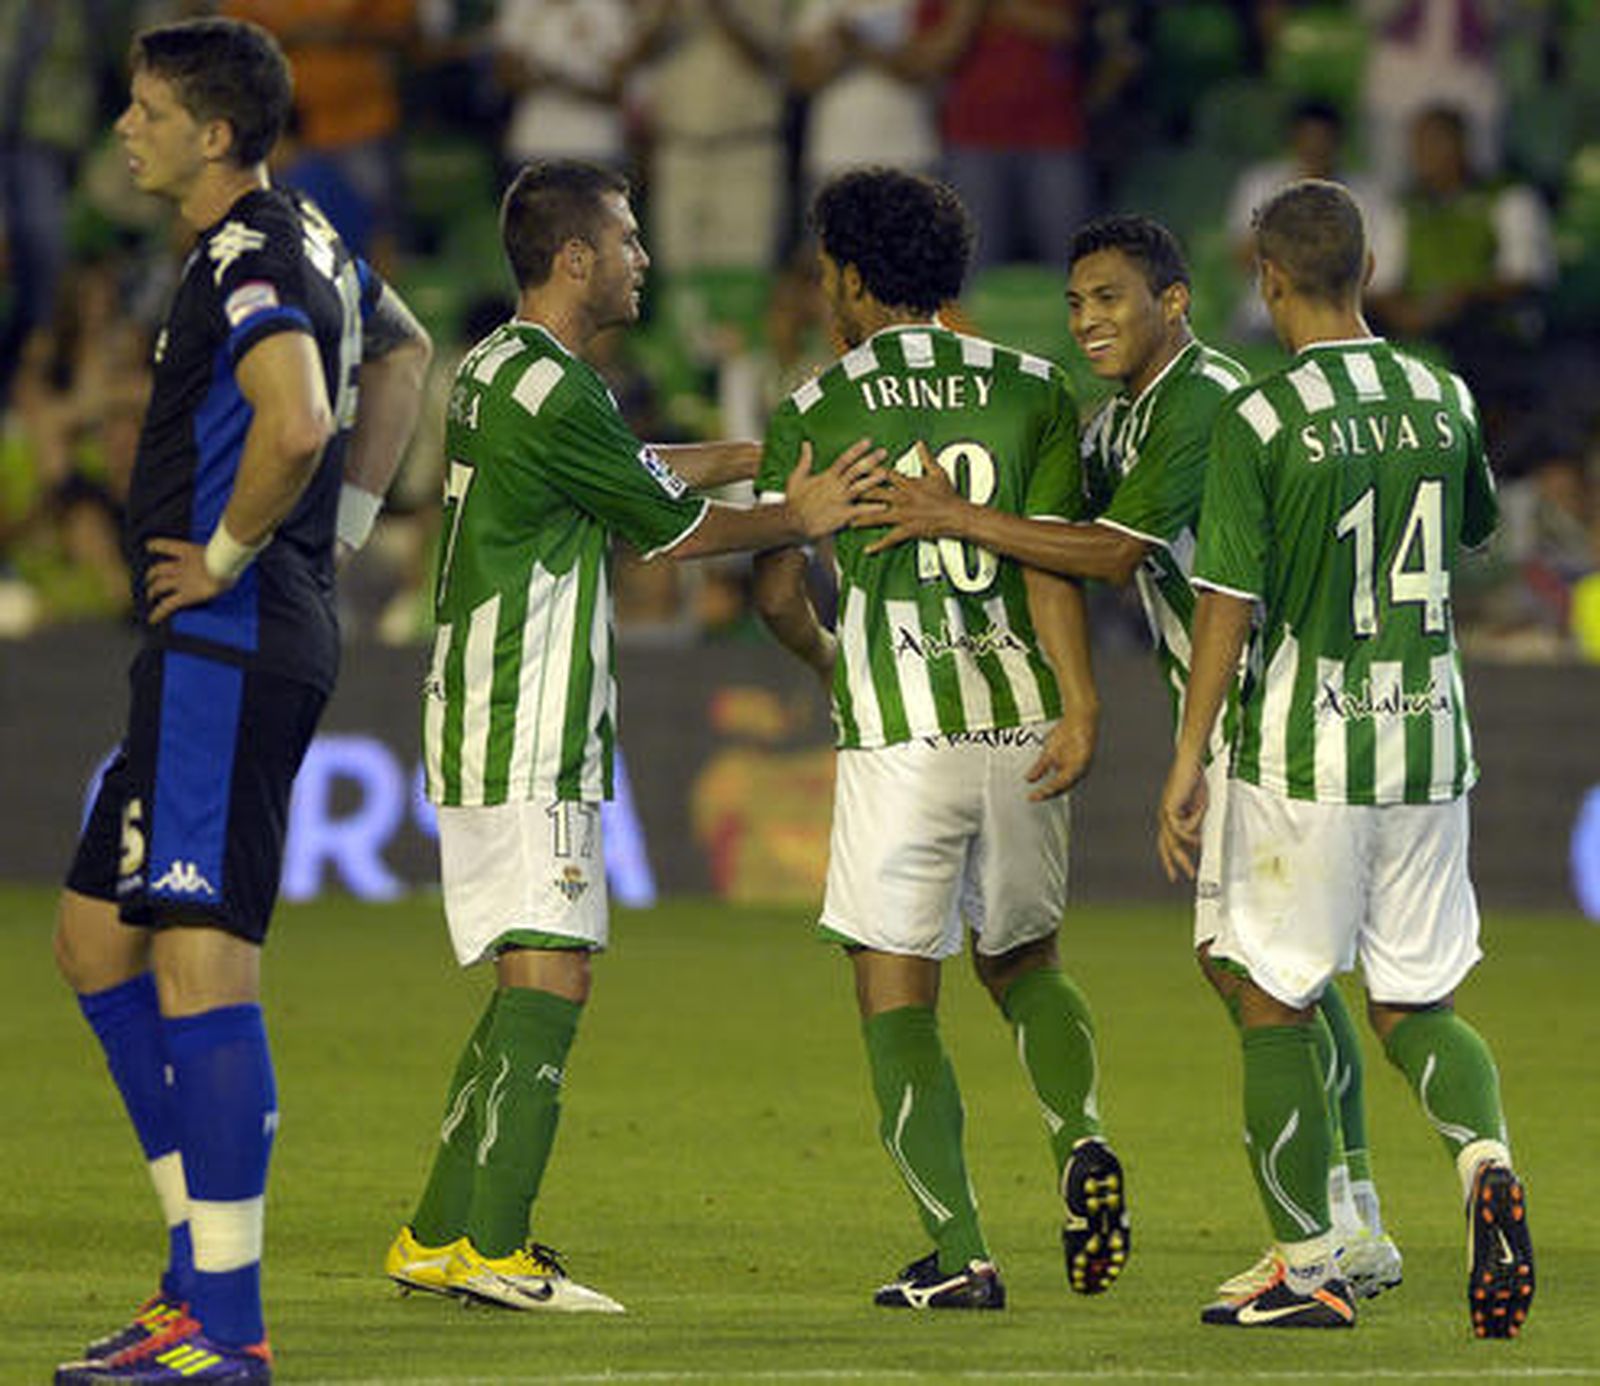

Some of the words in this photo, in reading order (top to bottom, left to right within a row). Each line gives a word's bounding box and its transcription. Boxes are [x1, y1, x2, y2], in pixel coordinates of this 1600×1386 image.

[860, 375, 994, 411] IRINEY
[1301, 413, 1420, 463] SALVA
[1434, 411, 1455, 449] S
[1335, 476, 1451, 638] 14
